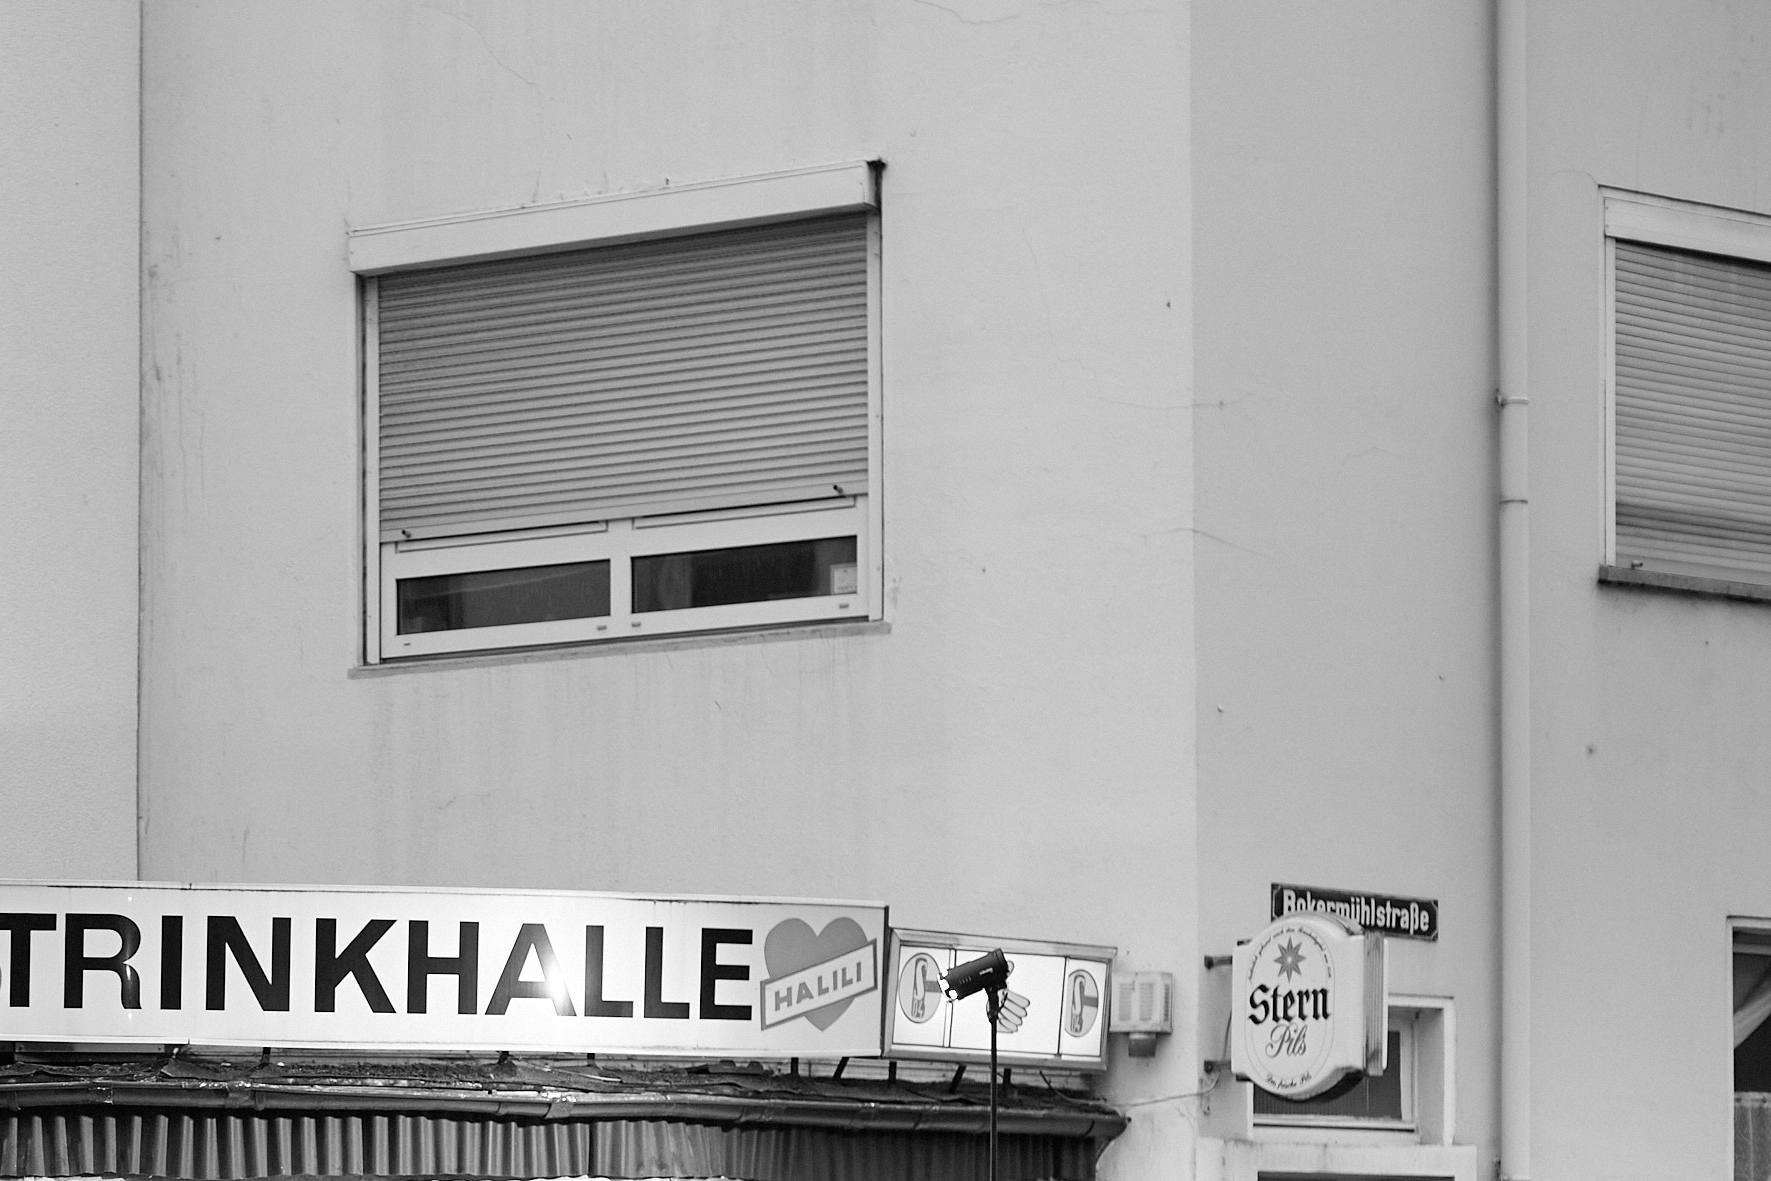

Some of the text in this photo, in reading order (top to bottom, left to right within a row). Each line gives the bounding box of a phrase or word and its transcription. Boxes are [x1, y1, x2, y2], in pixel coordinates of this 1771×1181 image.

[774, 961, 862, 1012] HALILI
[1248, 983, 1332, 1026] Stern
[1265, 1022, 1309, 1059] Pils
